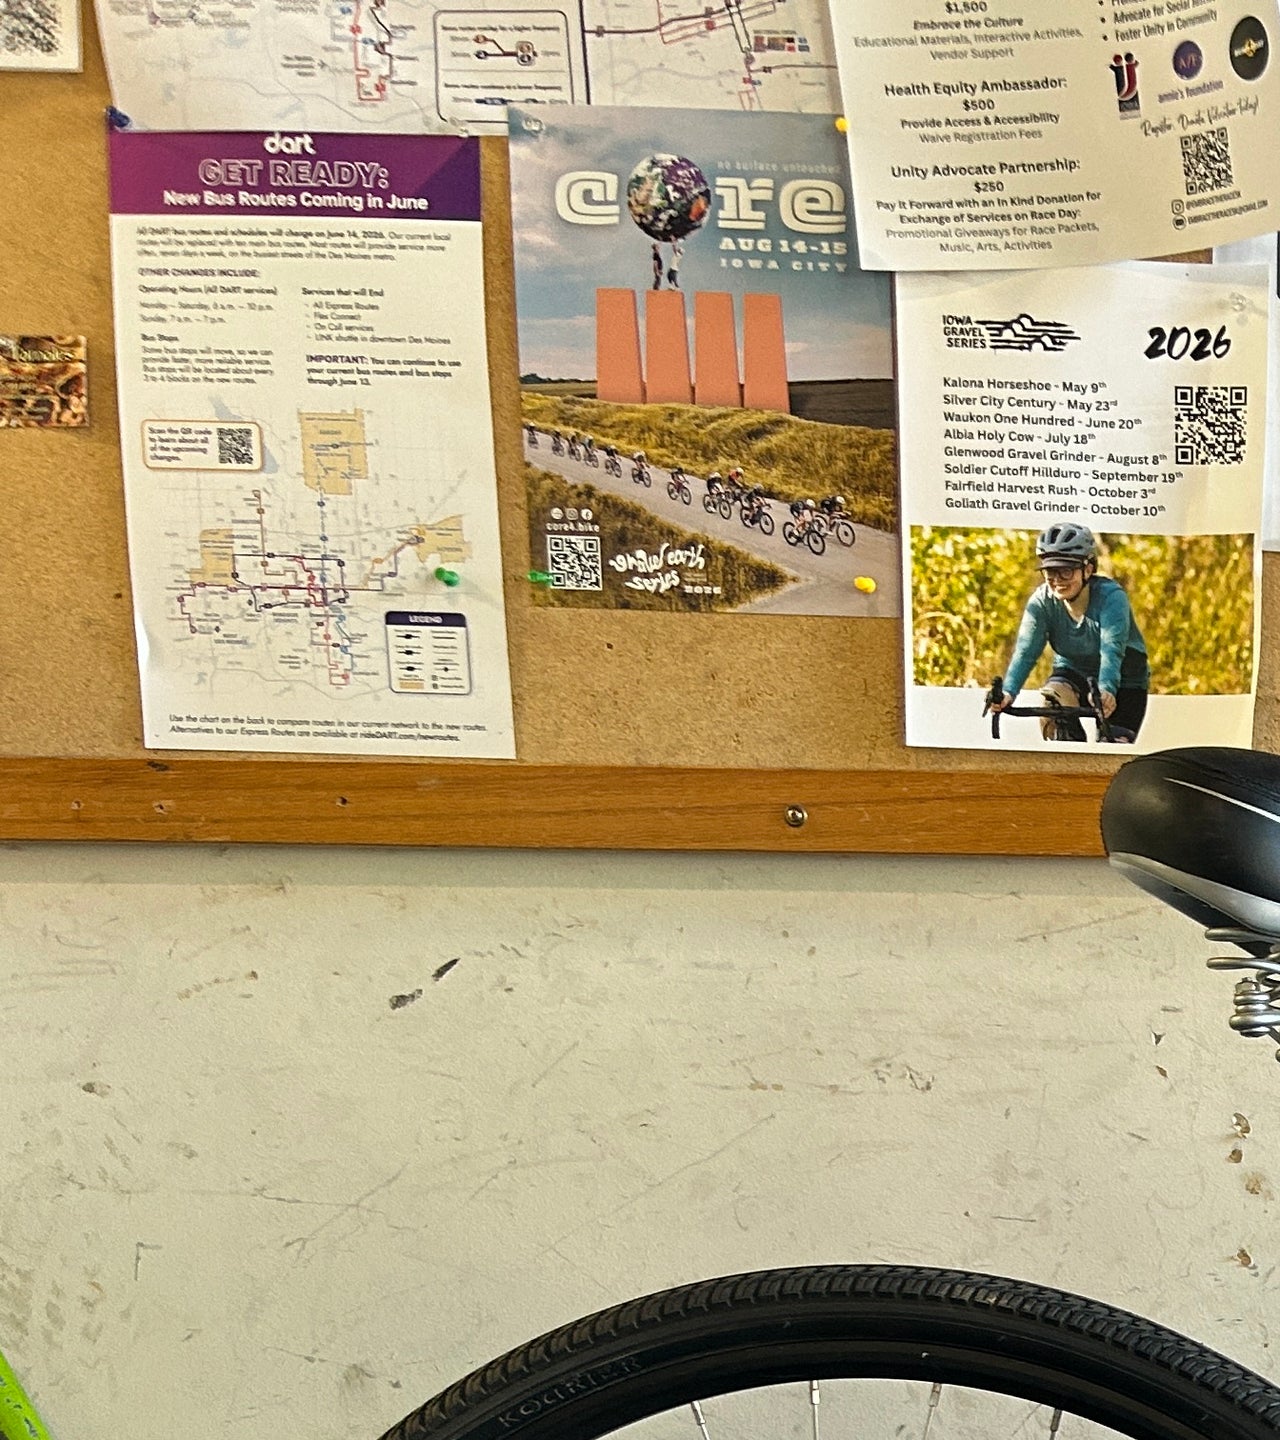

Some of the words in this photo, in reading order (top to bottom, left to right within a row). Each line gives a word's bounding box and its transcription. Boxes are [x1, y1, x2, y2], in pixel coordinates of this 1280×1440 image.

[884, 82, 930, 96] Health
[933, 80, 977, 96] Equity
[980, 76, 1066, 92] Ambassador:
[962, 98, 995, 111] $500
[263, 132, 316, 155] dart
[200, 159, 263, 188] GET
[270, 160, 390, 189] READY:
[890, 165, 928, 180] Unity
[932, 164, 996, 176] Advocate
[998, 157, 1080, 174] Partnership:
[973, 180, 1004, 193] $250
[163, 190, 200, 205] New
[203, 190, 236, 206] Bus
[238, 190, 297, 207] Routes
[299, 191, 364, 211] Coming
[366, 192, 383, 208] in
[385, 193, 428, 210] June
[718, 237, 772, 253] AUG
[942, 314, 974, 326] IOWA
[943, 326, 984, 337] GRAVEL
[946, 337, 987, 349] SERIES
[1144, 325, 1232, 361] 2026
[943, 376, 984, 388] Kalona
[987, 378, 1051, 391] Horseshoe
[1061, 381, 1088, 395] May
[1090, 381, 1106, 393] 9th
[943, 393, 977, 405] Silver
[979, 395, 1004, 409] City
[1007, 396, 1056, 411] Century
[1066, 399, 1092, 413] May
[1095, 399, 1118, 411] 23rd
[943, 445, 1004, 458] Glenwood
[1007, 448, 1047, 460] Gravel
[1049, 449, 1096, 462] Grinder
[1106, 452, 1149, 466] August
[1151, 453, 1167, 465] 8th
[945, 497, 988, 509] Goliath
[991, 498, 1031, 511] Gravel
[1033, 500, 1080, 512] Grinder
[1090, 503, 1140, 515] October
[1142, 504, 1165, 517] 10th
